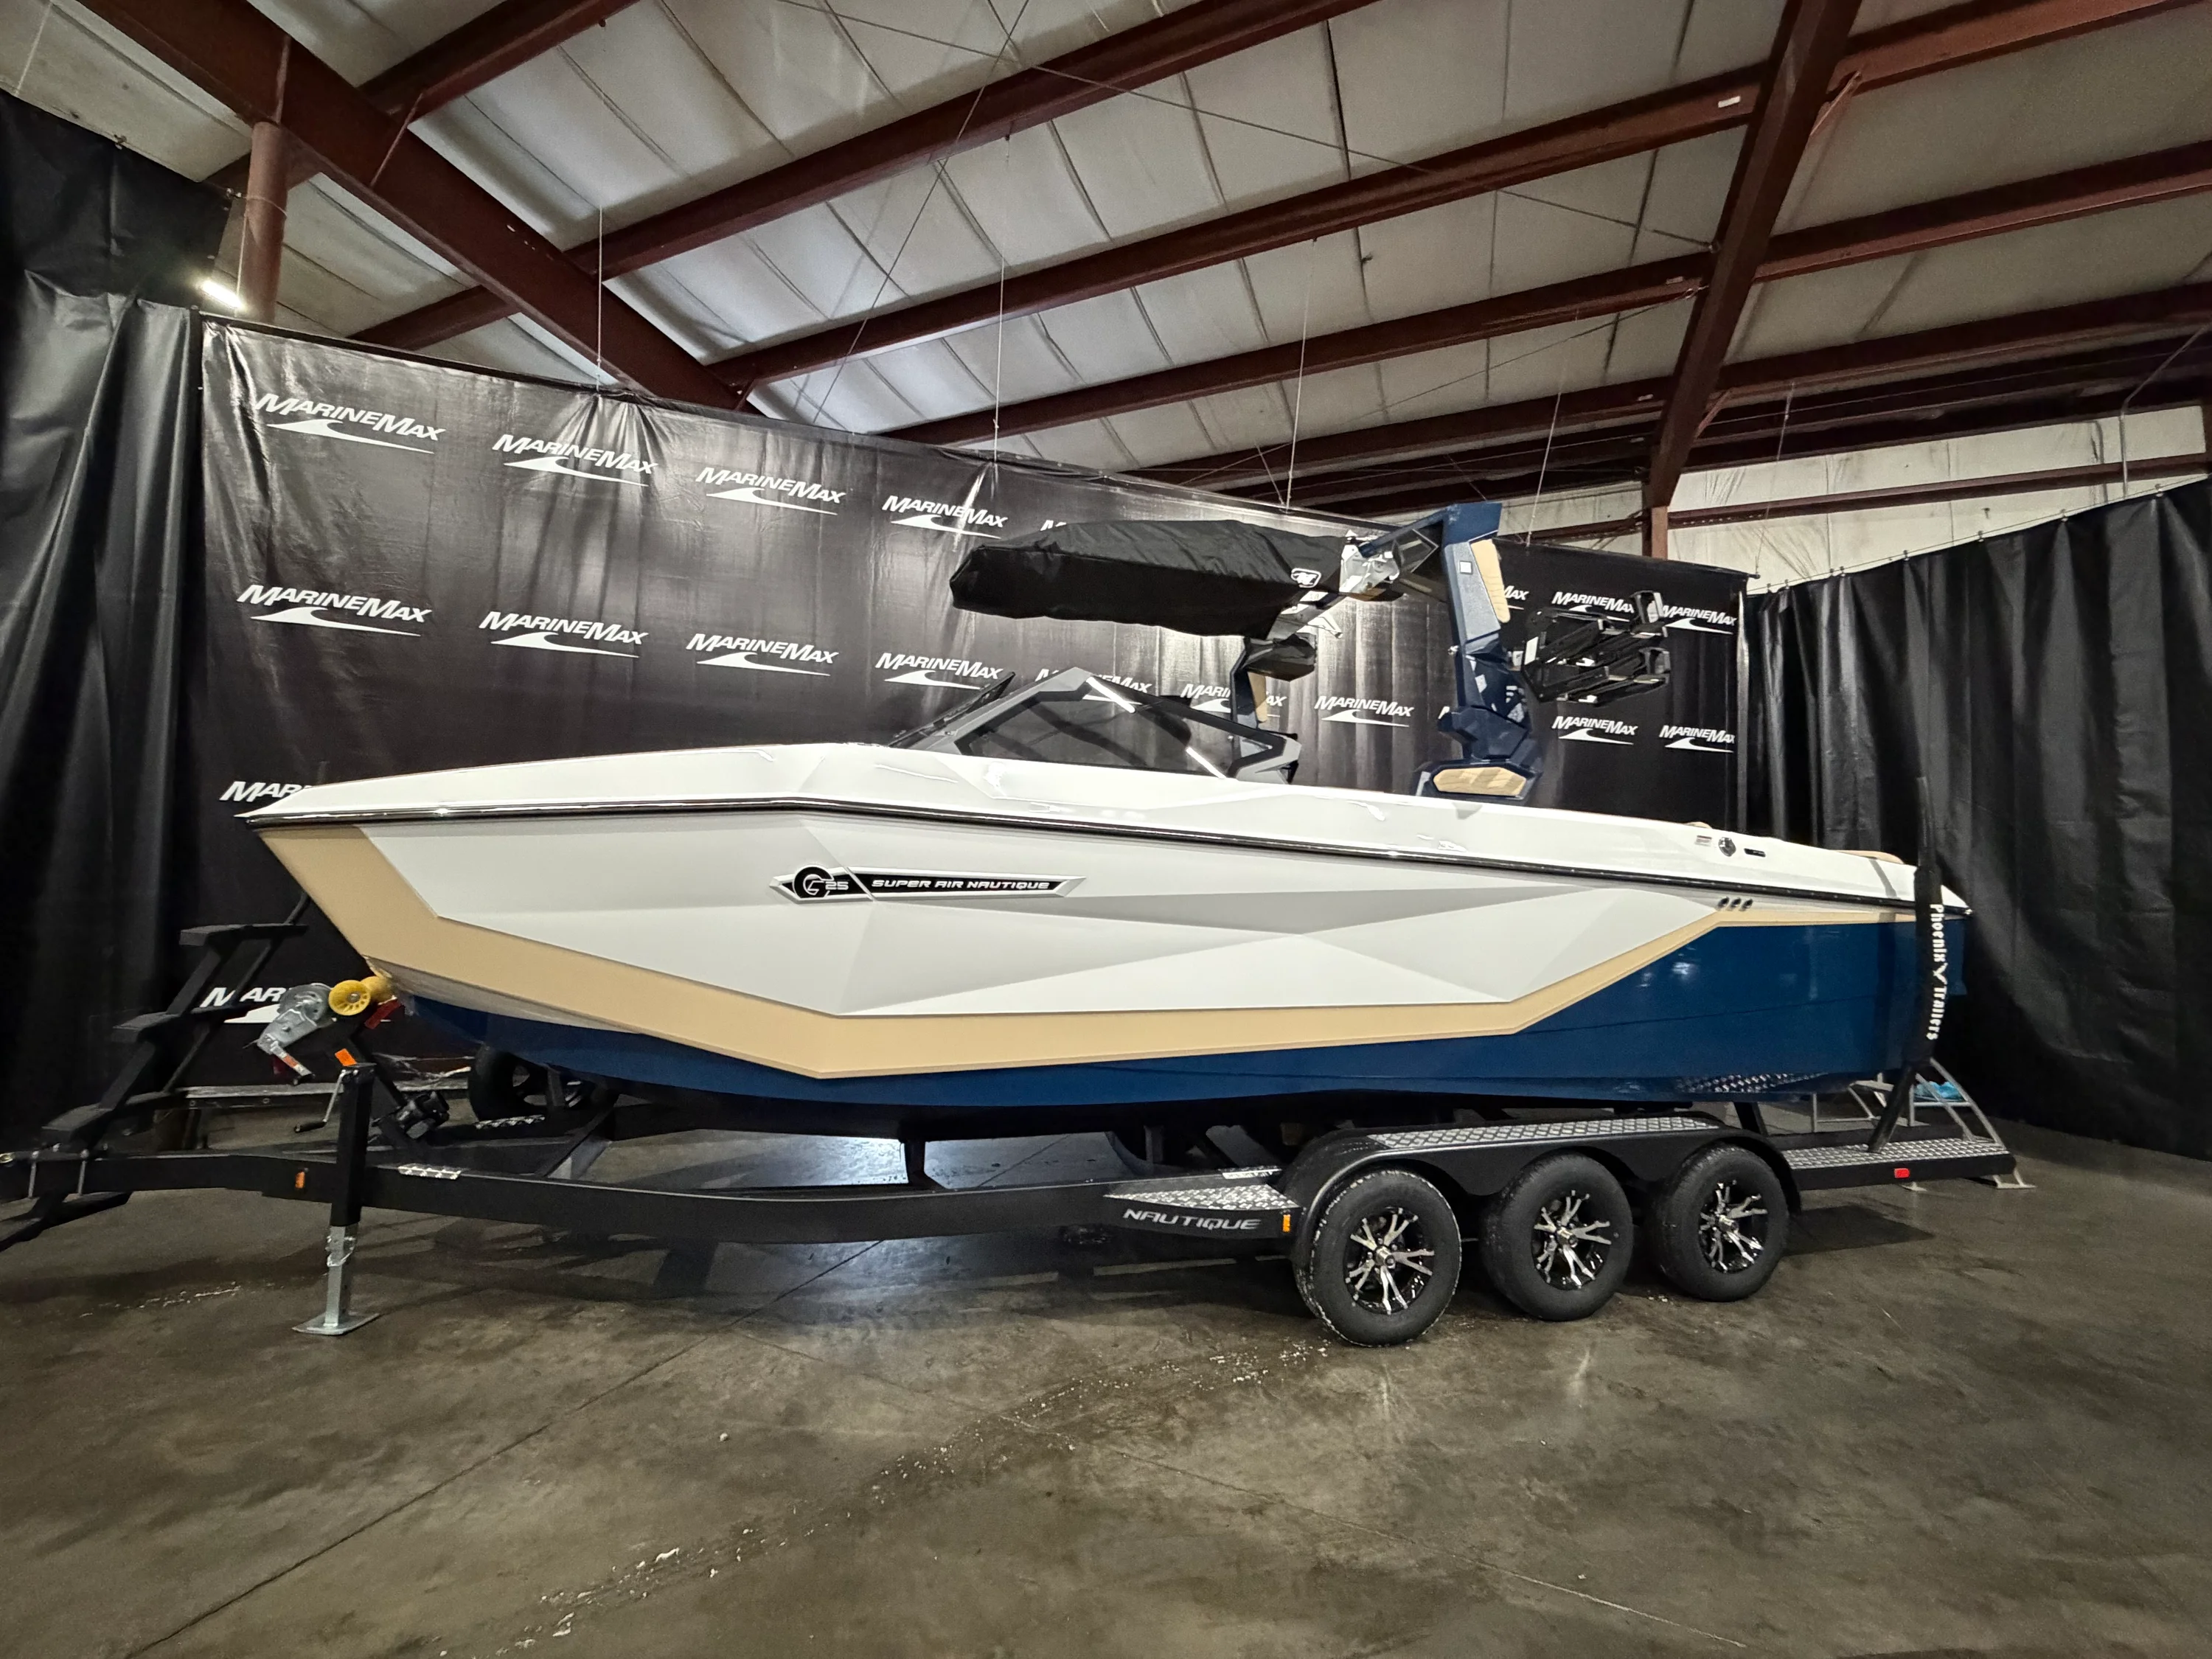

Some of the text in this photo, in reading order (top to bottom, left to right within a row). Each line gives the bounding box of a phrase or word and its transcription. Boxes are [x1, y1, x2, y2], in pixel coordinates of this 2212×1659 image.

[872, 880, 930, 888] SUPER
[935, 880, 962, 888] AIR
[966, 881, 1050, 890] NAUTIQUE
[1926, 904, 1948, 1040] Phoenix Trailers
[1123, 1208, 1262, 1230] NAUTIQUE
